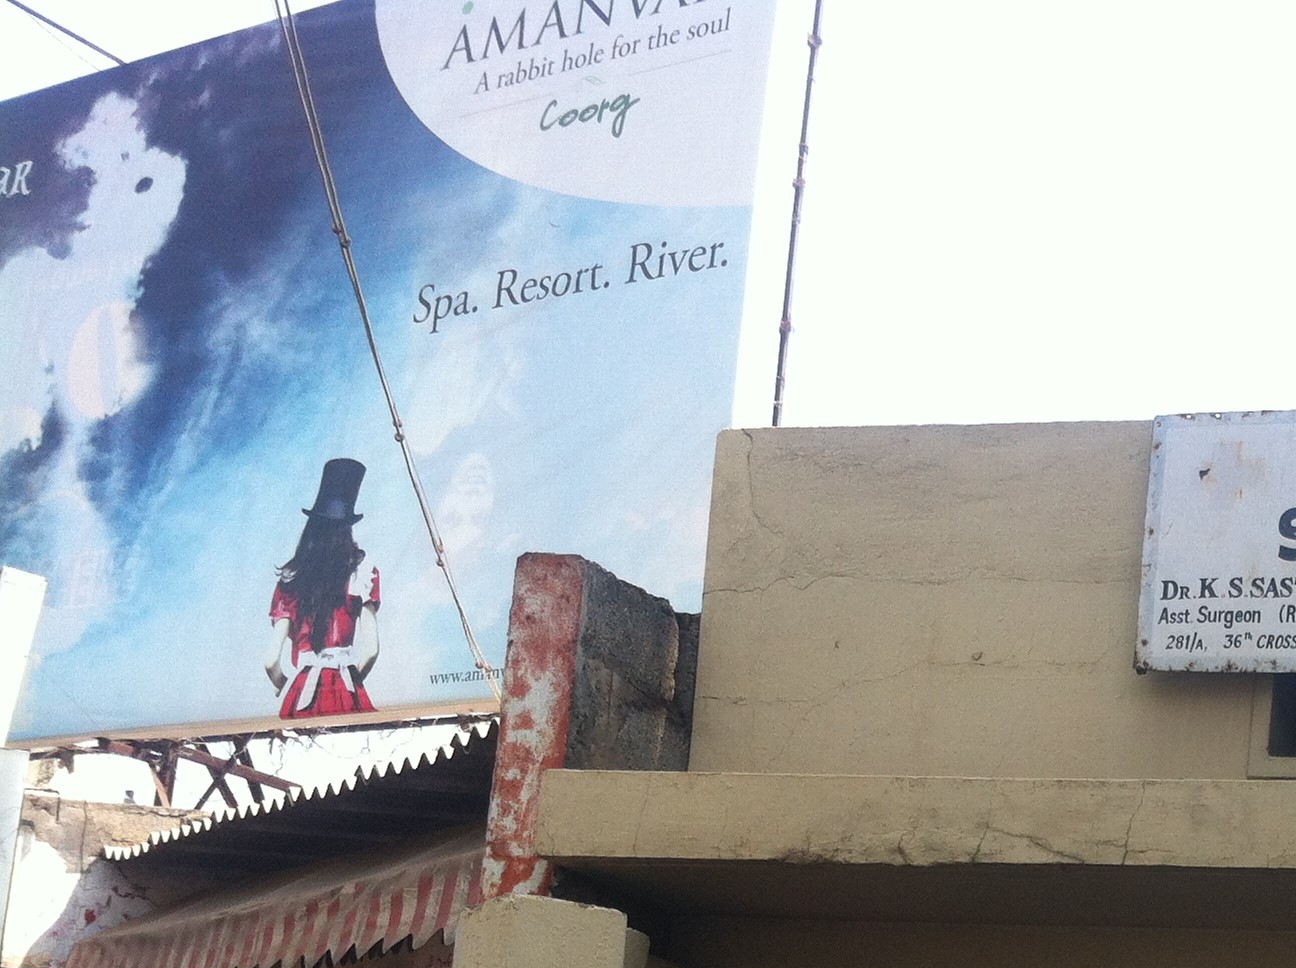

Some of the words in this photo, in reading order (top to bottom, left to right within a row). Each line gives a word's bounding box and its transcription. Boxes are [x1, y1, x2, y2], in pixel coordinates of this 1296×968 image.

[473, 71, 490, 94] A
[497, 57, 554, 89] rabbit
[561, 43, 605, 73] hole
[611, 34, 641, 60] for
[648, 25, 681, 51] the
[686, 6, 732, 41] soul
[539, 93, 641, 138] Coorg
[412, 284, 479, 334] Spa.
[491, 268, 611, 310] Resort.
[624, 241, 729, 285] River.
[1196, 605, 1261, 628] Surgeon
